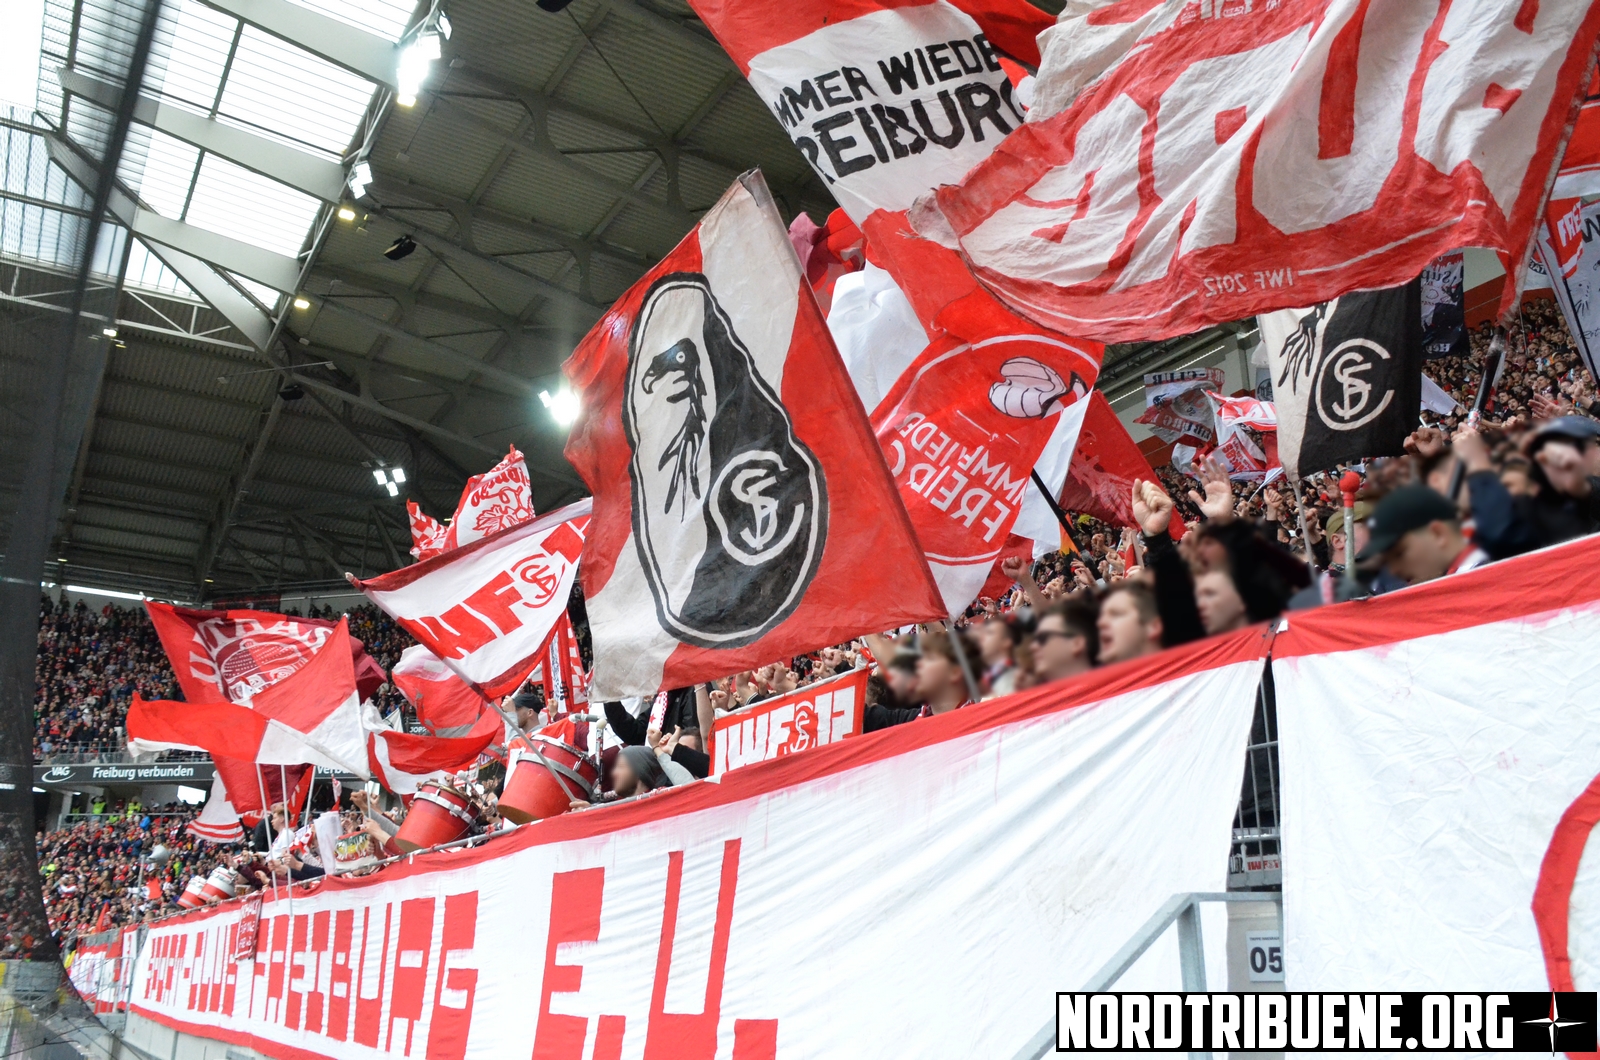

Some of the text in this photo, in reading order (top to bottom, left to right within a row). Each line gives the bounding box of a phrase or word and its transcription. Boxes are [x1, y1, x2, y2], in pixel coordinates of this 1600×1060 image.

[51, 764, 194, 780] VAG Freiburg verbunden
[1249, 946, 1283, 974] 05
